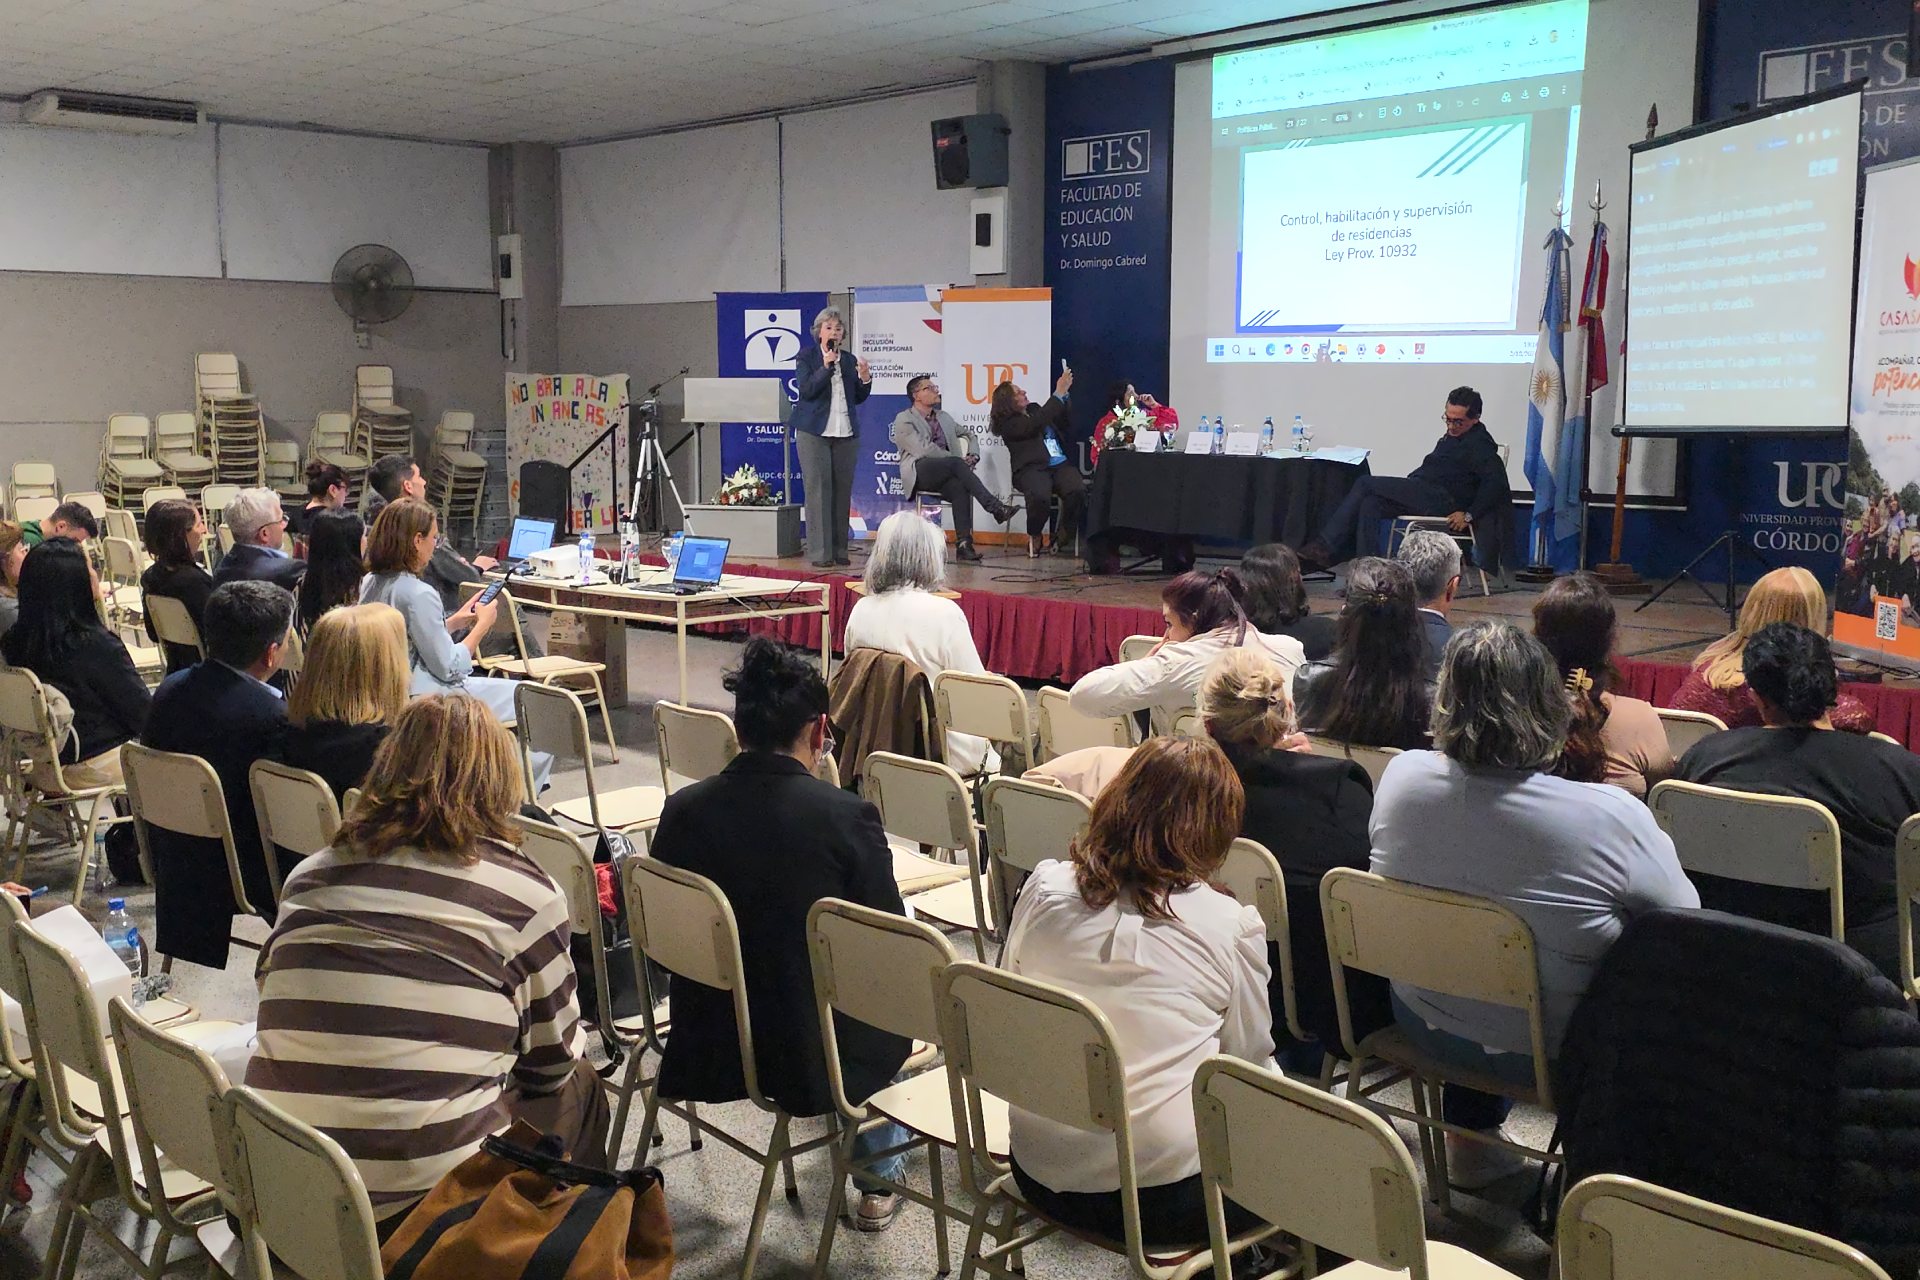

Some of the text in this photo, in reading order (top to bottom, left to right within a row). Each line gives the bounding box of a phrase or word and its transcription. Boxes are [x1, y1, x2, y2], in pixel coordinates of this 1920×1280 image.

[1808, 40, 1908, 93] FES
[1875, 103, 1907, 126] DE
[1088, 136, 1143, 173] FES
[1061, 182, 1142, 204] FACULTAD DE
[1060, 204, 1134, 227] EDUCACIÓN
[1280, 200, 1473, 226] Control, habilitación y supervisión
[1061, 230, 1112, 248] Y SALUD
[1331, 225, 1412, 242] de residencias
[1325, 243, 1417, 263] Ley Prov. 10932
[1060, 254, 1147, 270] Dr. Domingo Cabred
[862, 337, 894, 345] INCLUSIÓN
[869, 363, 904, 371] NCULACIÓN
[870, 371, 893, 379] ESTIÓN
[963, 414, 992, 422] UNIVE
[746, 425, 753, 434] Y
[963, 425, 990, 434] PROV
[874, 450, 901, 461] Córd
[1742, 513, 1842, 527] NIVERSIDAD PROV
[1753, 527, 1841, 553] CÓRDO
